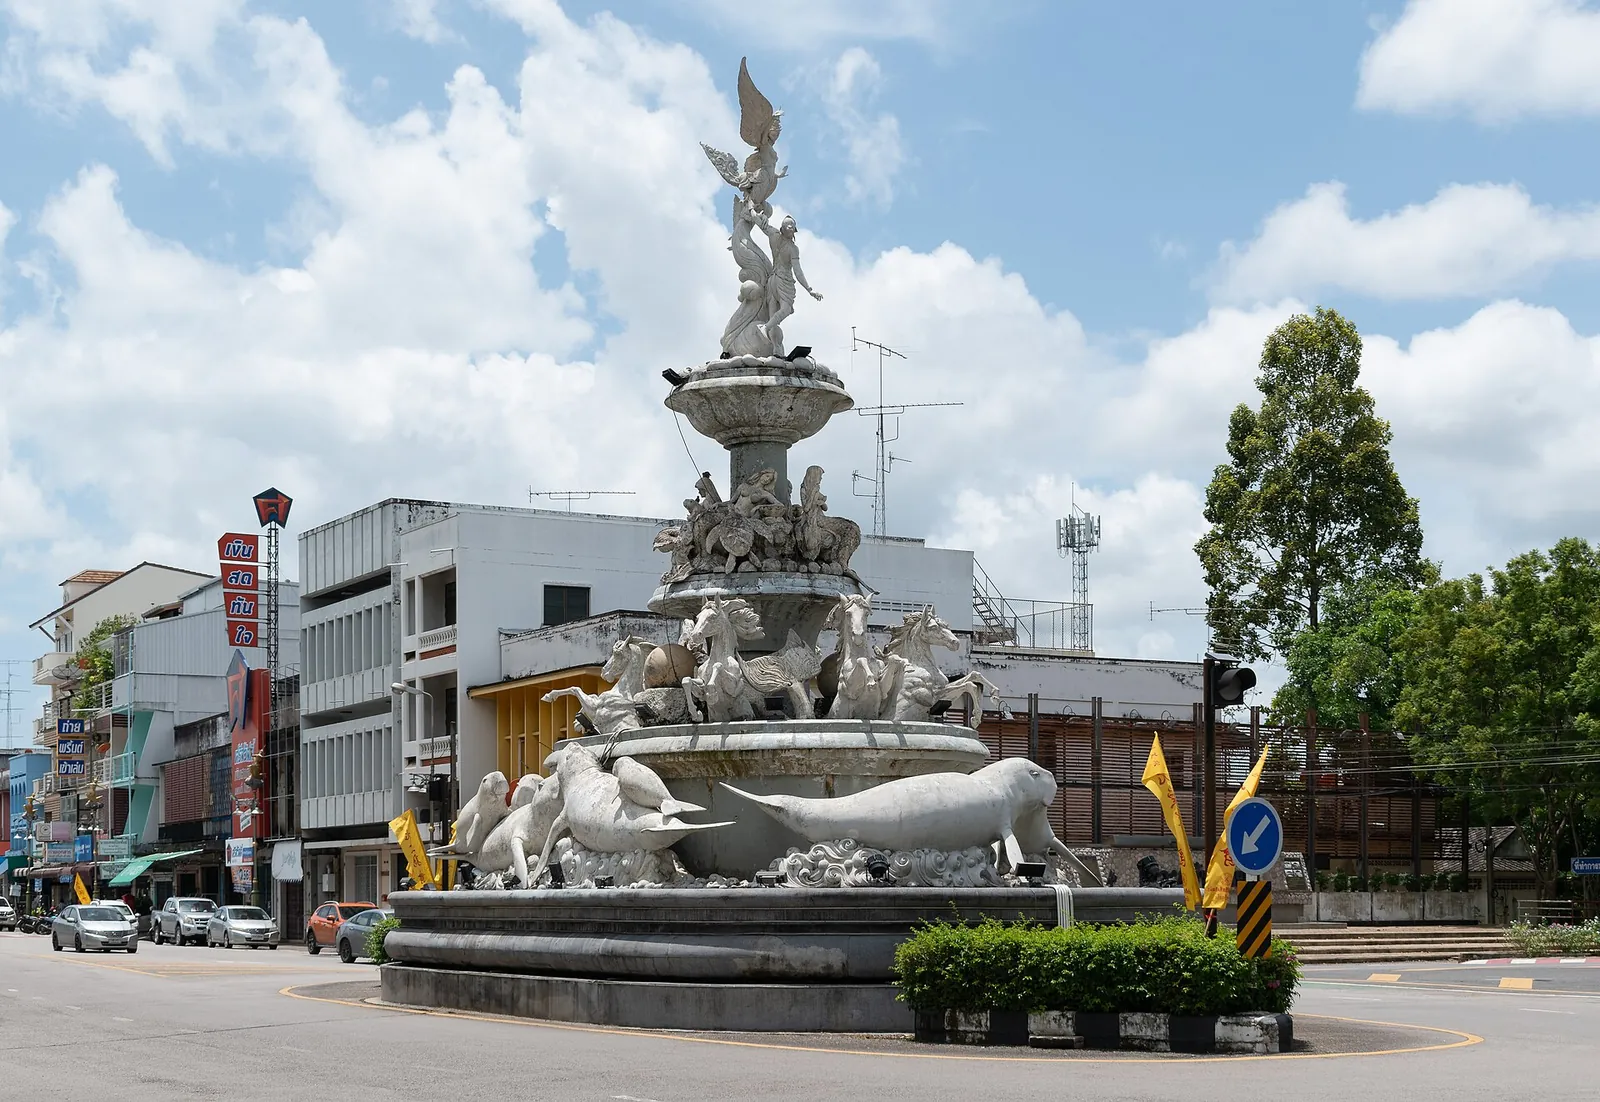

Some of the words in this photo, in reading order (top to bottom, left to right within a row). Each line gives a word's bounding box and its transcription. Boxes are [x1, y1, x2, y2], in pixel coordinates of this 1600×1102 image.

[224, 539, 254, 559] เงิน
[228, 570, 253, 586] สด
[230, 596, 254, 615] ทัน
[235, 624, 254, 644] ใจ
[61, 719, 81, 733] ถ่าย
[58, 740, 84, 754] พริ้นต์
[59, 761, 84, 774] เข้าเล่ม
